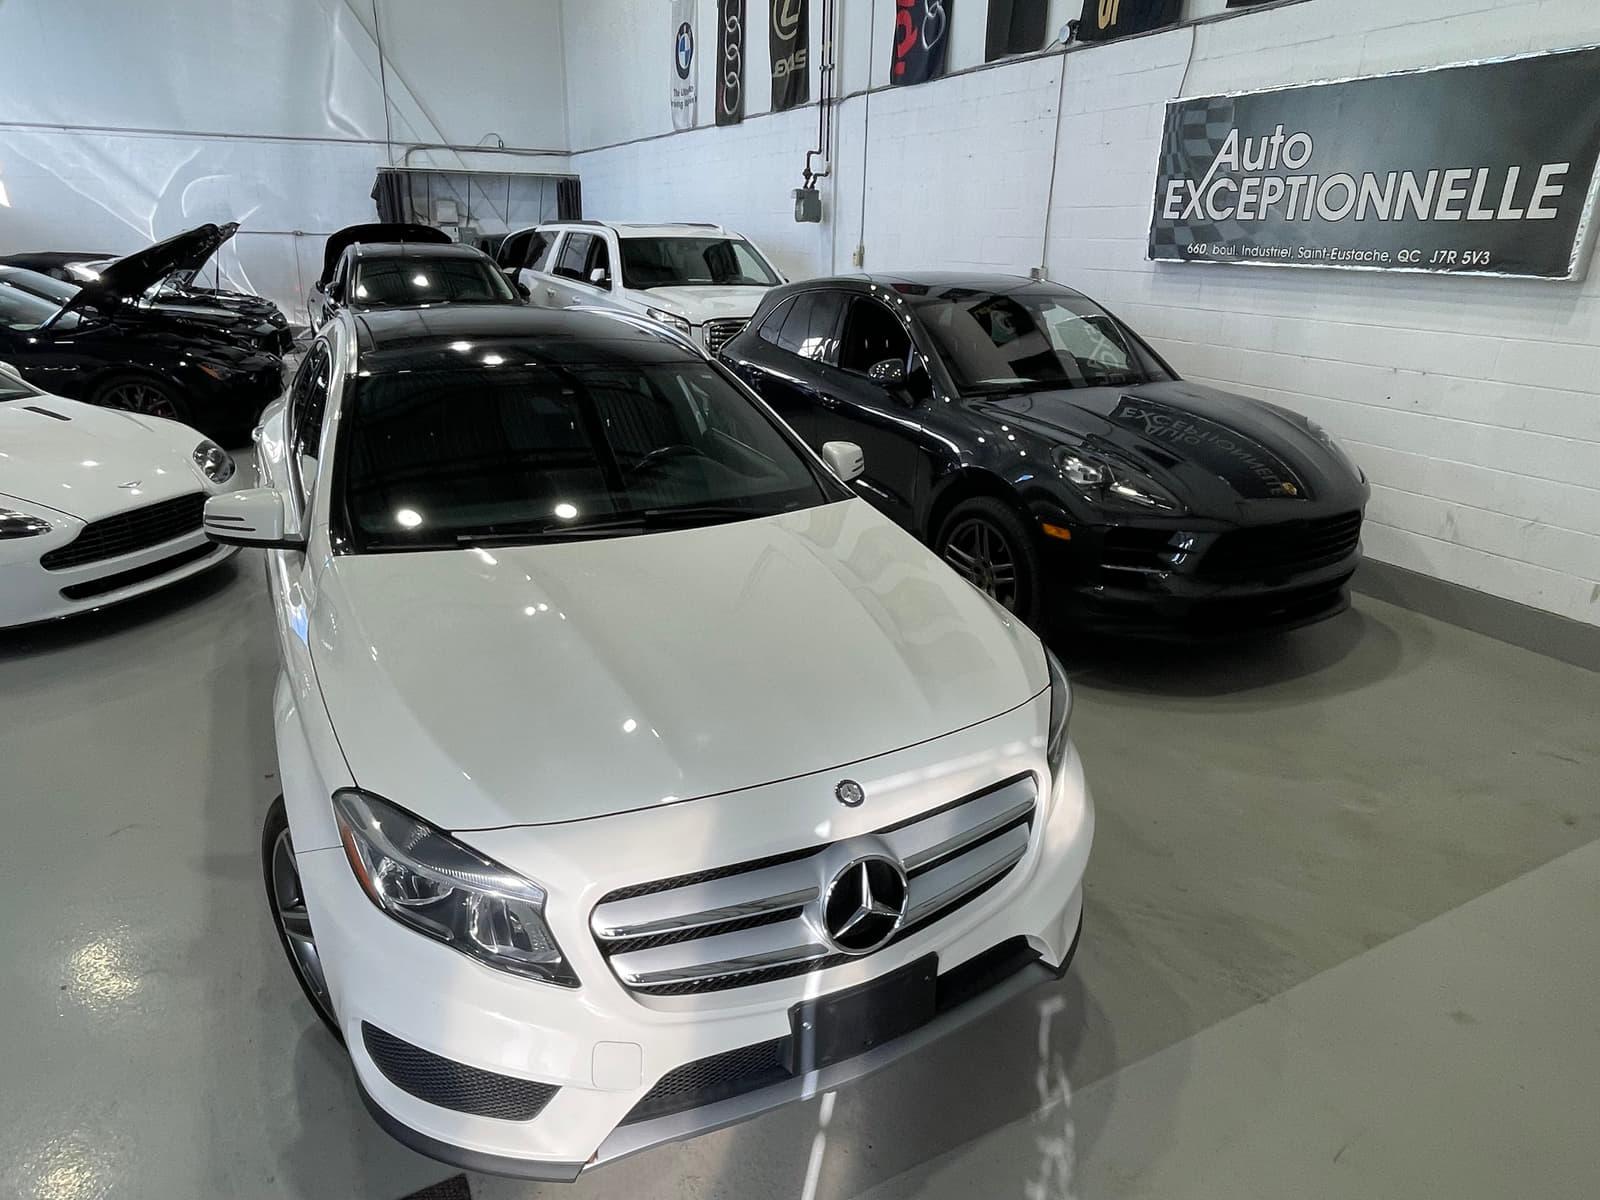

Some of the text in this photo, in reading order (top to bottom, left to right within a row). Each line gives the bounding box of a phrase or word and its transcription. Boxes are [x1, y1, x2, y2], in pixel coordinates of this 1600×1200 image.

[1209, 124, 1314, 172] Auto
[1162, 163, 1570, 222] EXCEPTIONNELLE
[1212, 244, 1239, 256] boul.
[1298, 246, 1392, 263] Saint-Eustache,
[1398, 249, 1422, 263] QC
[1430, 250, 1458, 264] J7R
[1462, 250, 1491, 265] 5V3
